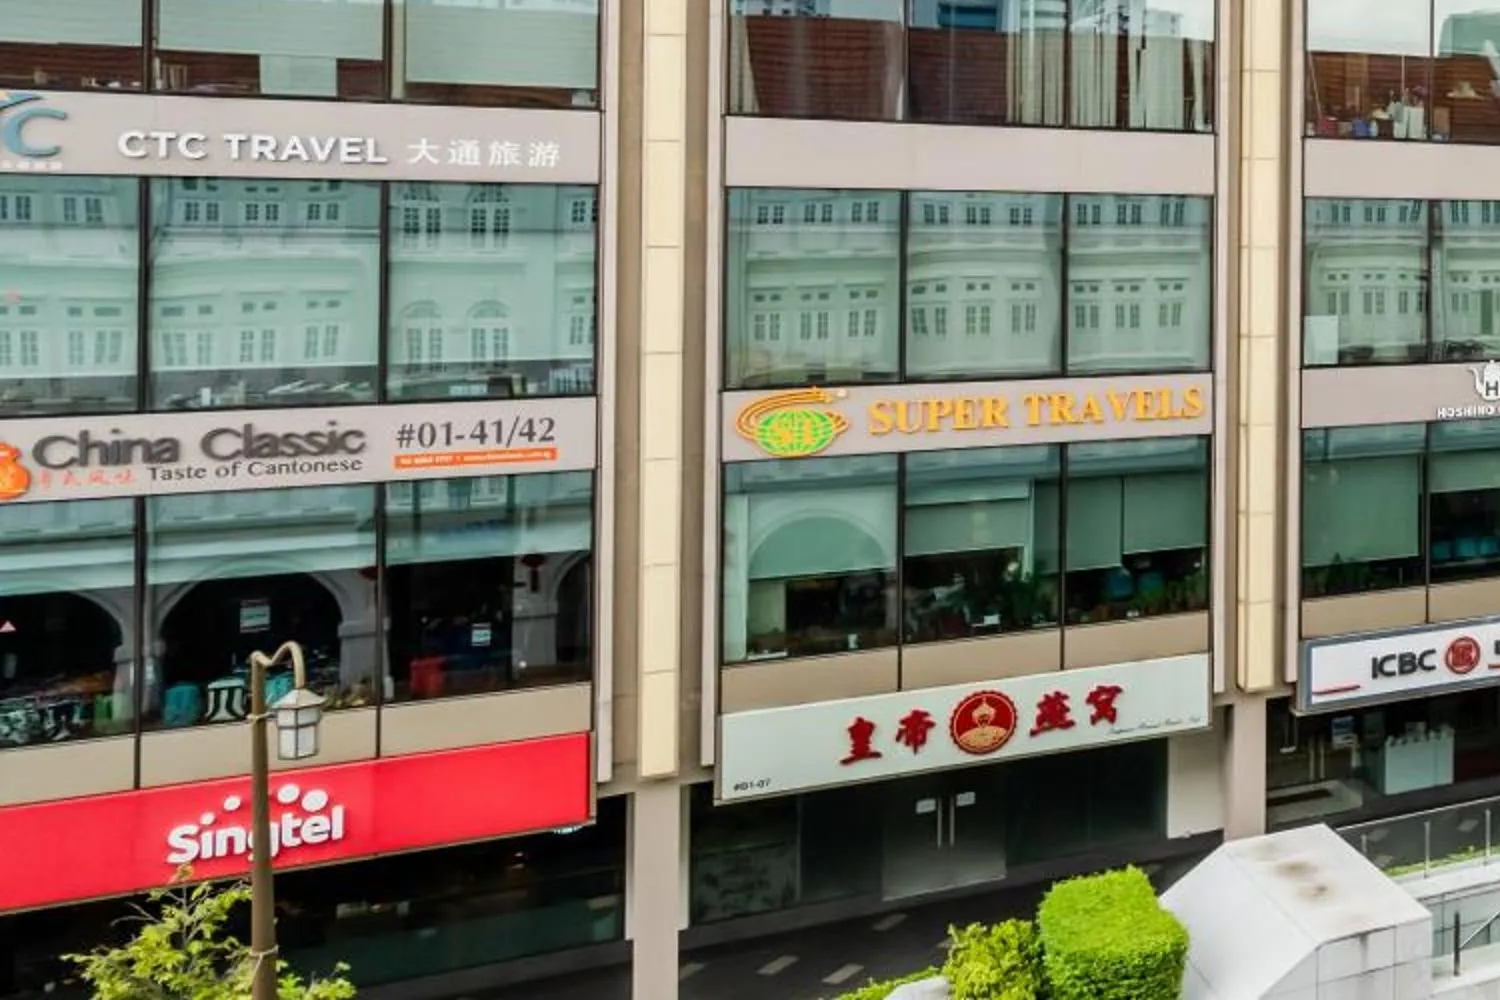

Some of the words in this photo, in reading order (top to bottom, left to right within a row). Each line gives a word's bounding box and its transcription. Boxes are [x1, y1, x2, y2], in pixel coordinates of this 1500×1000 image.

[117, 131, 208, 159] CTC
[223, 134, 389, 164] TRAVEL
[406, 138, 562, 168] 大通旅游
[868, 396, 1009, 435] SUPER
[1023, 387, 1205, 427] TRAVELS
[1437, 404, 1495, 418] HOSHINO
[32, 428, 180, 470] China
[201, 420, 367, 462] Classic
[396, 415, 556, 449] #01-41/42
[148, 464, 207, 481] Taste
[215, 461, 241, 478] of
[247, 458, 363, 477] Cantonese
[1371, 649, 1437, 679] ICBC
[840, 709, 937, 765] 皇帝
